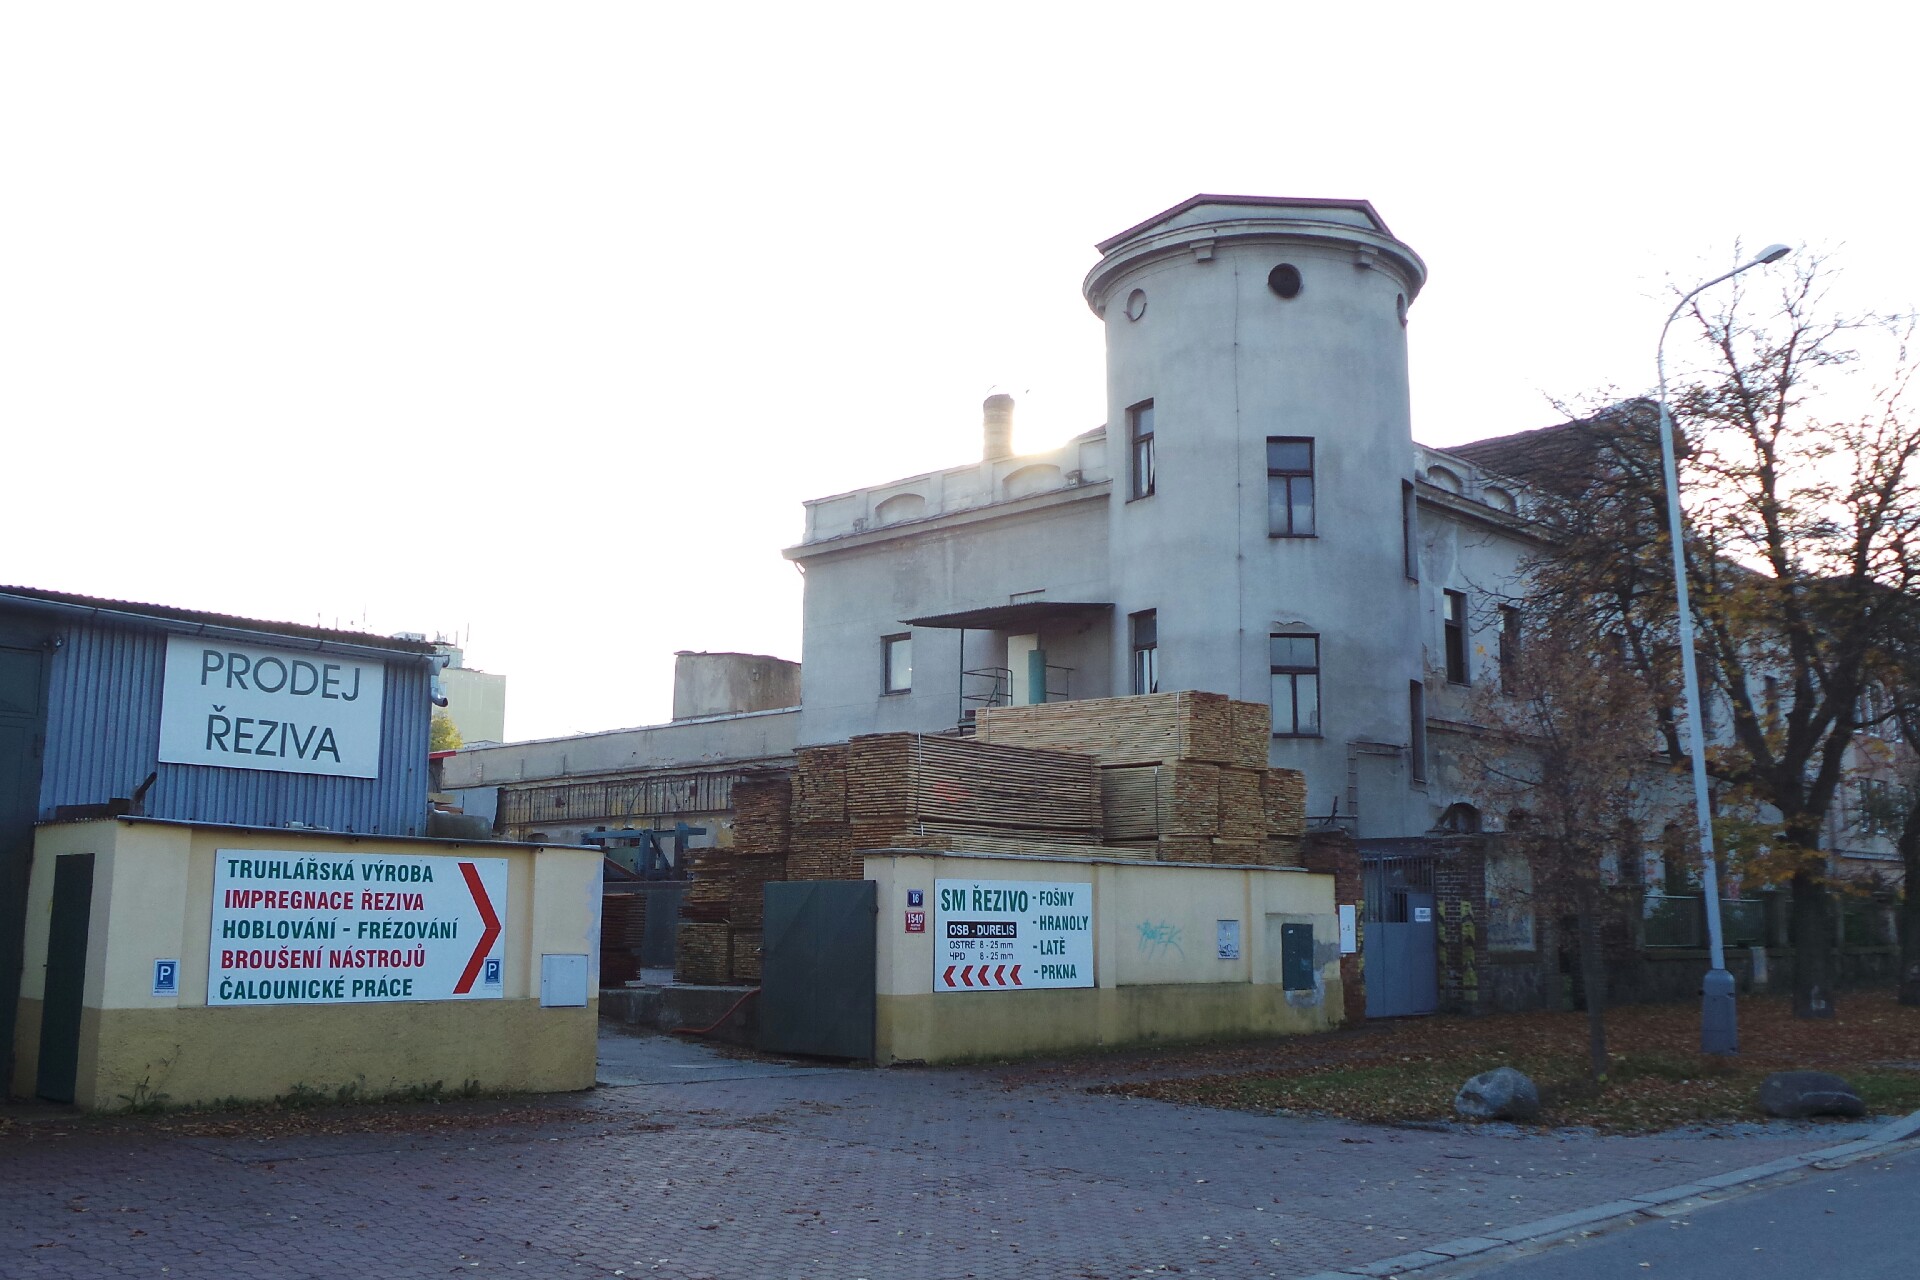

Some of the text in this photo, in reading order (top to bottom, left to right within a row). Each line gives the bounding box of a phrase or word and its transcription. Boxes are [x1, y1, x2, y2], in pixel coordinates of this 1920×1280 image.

[201, 649, 360, 701] PRODEJ
[206, 704, 341, 763] ŘEZIVA
[227, 857, 434, 883] TRUHLÁŘSKÁ VÝROBA
[224, 888, 424, 911] IMPREGNACE ŘEZIVA
[912, 893, 920, 904] 16
[941, 884, 1029, 913] SM ŘEZIVO
[1039, 887, 1074, 907] FOŠNY
[222, 916, 338, 940] HOBLOVÁNÍ
[357, 917, 459, 939] FRÉZOVÁNÍ
[907, 913, 924, 924] 1540
[1039, 915, 1089, 931] HRANOLY
[949, 924, 969, 936] OSB
[976, 924, 1015, 936] DURELIS
[949, 939, 976, 949] OSTRÉ
[979, 940, 984, 949] 8
[990, 940, 999, 949] 25
[1000, 941, 1014, 949] mm
[1040, 936, 1066, 955] LATĚ
[221, 943, 425, 969] BROUŠENÍ NÁSTROJŮ
[990, 951, 999, 961] 25
[160, 965, 171, 981] P
[488, 962, 497, 977] P
[1041, 964, 1077, 980] PRKNA
[219, 975, 413, 1000] ČALOUNICKÉ PRÁCE
